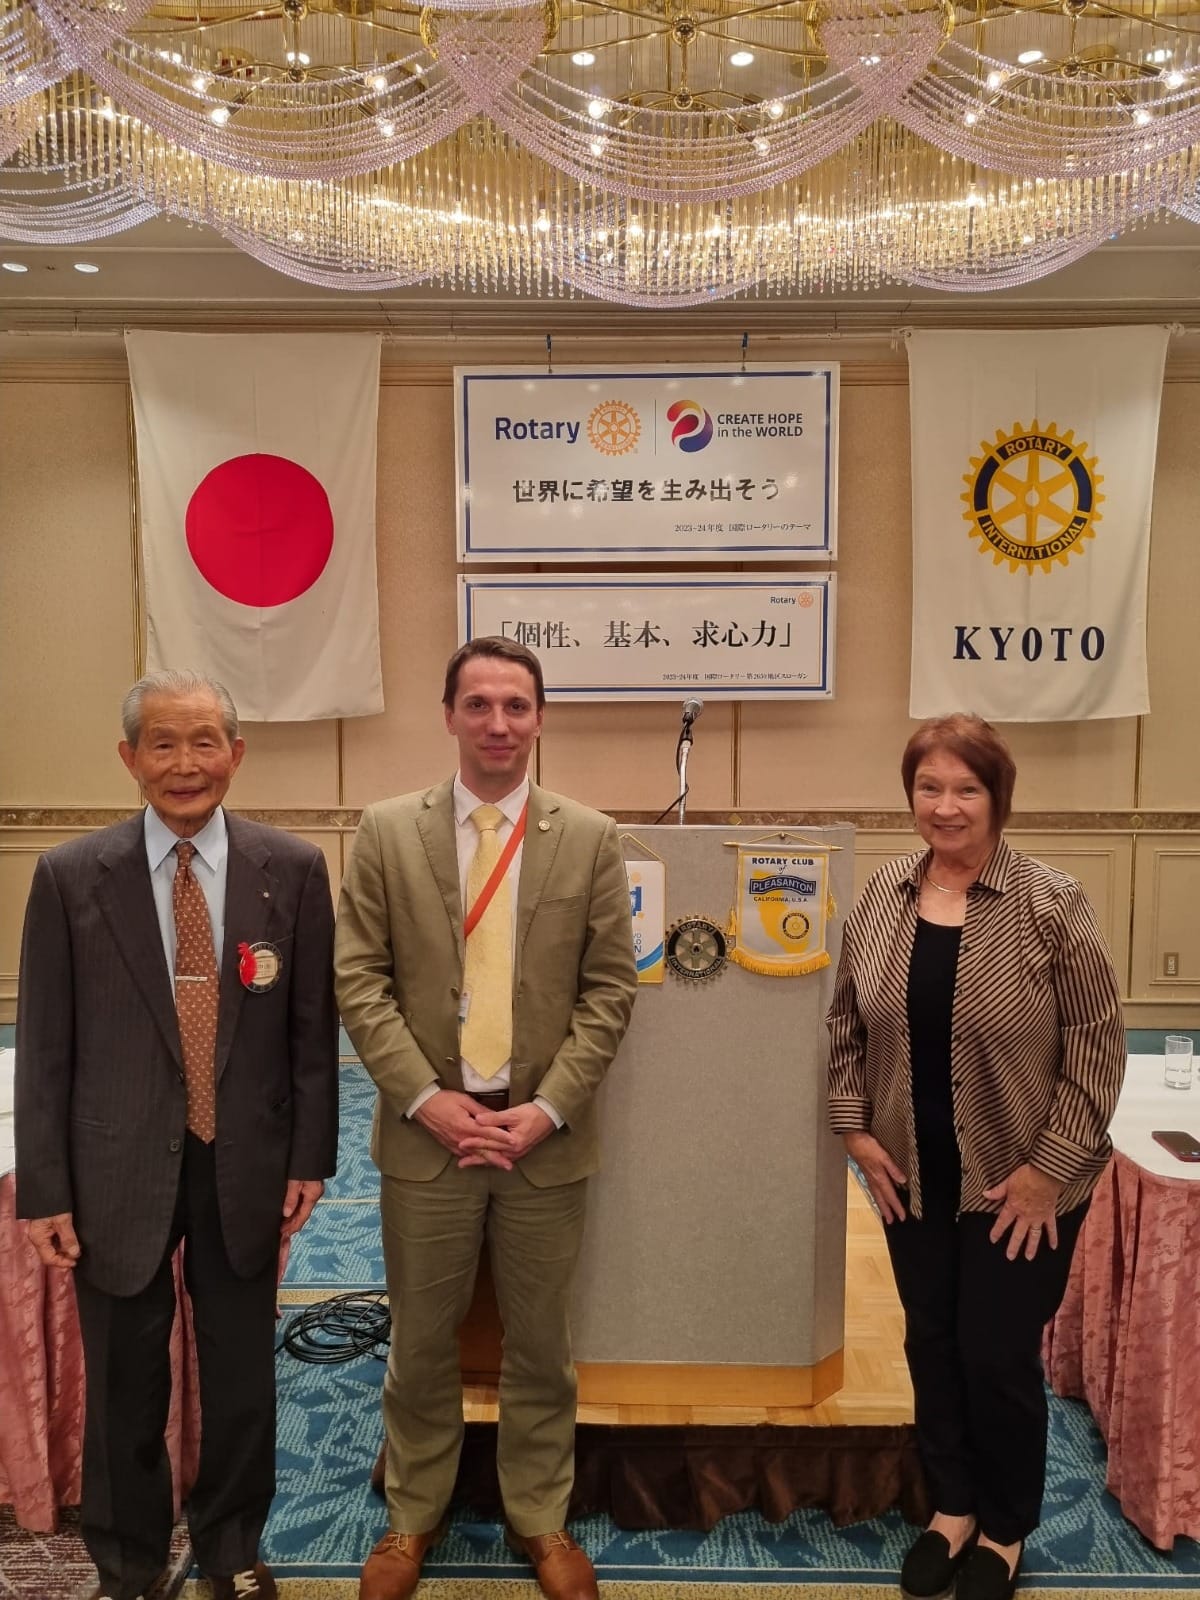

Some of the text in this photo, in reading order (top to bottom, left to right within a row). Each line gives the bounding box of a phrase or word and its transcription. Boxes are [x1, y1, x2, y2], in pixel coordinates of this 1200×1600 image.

[717, 413, 803, 425] CREATE HOPE
[495, 417, 580, 443] Rotary
[717, 426, 803, 437] in the WORLD
[1005, 436, 1066, 457] ROTARY
[512, 478, 779, 503] 世界に希望を生み出そう
[981, 519, 1085, 560] INTERNATIONAL
[770, 596, 797, 605] Rotary
[953, 625, 1105, 662] KYOTO
[752, 857, 814, 866] ROTARY CLUB
[778, 865, 787, 875] of
[752, 878, 813, 893] PLEASANTON
[681, 920, 714, 932] ROTARY
[670, 958, 722, 978] INTERNATIONAL
